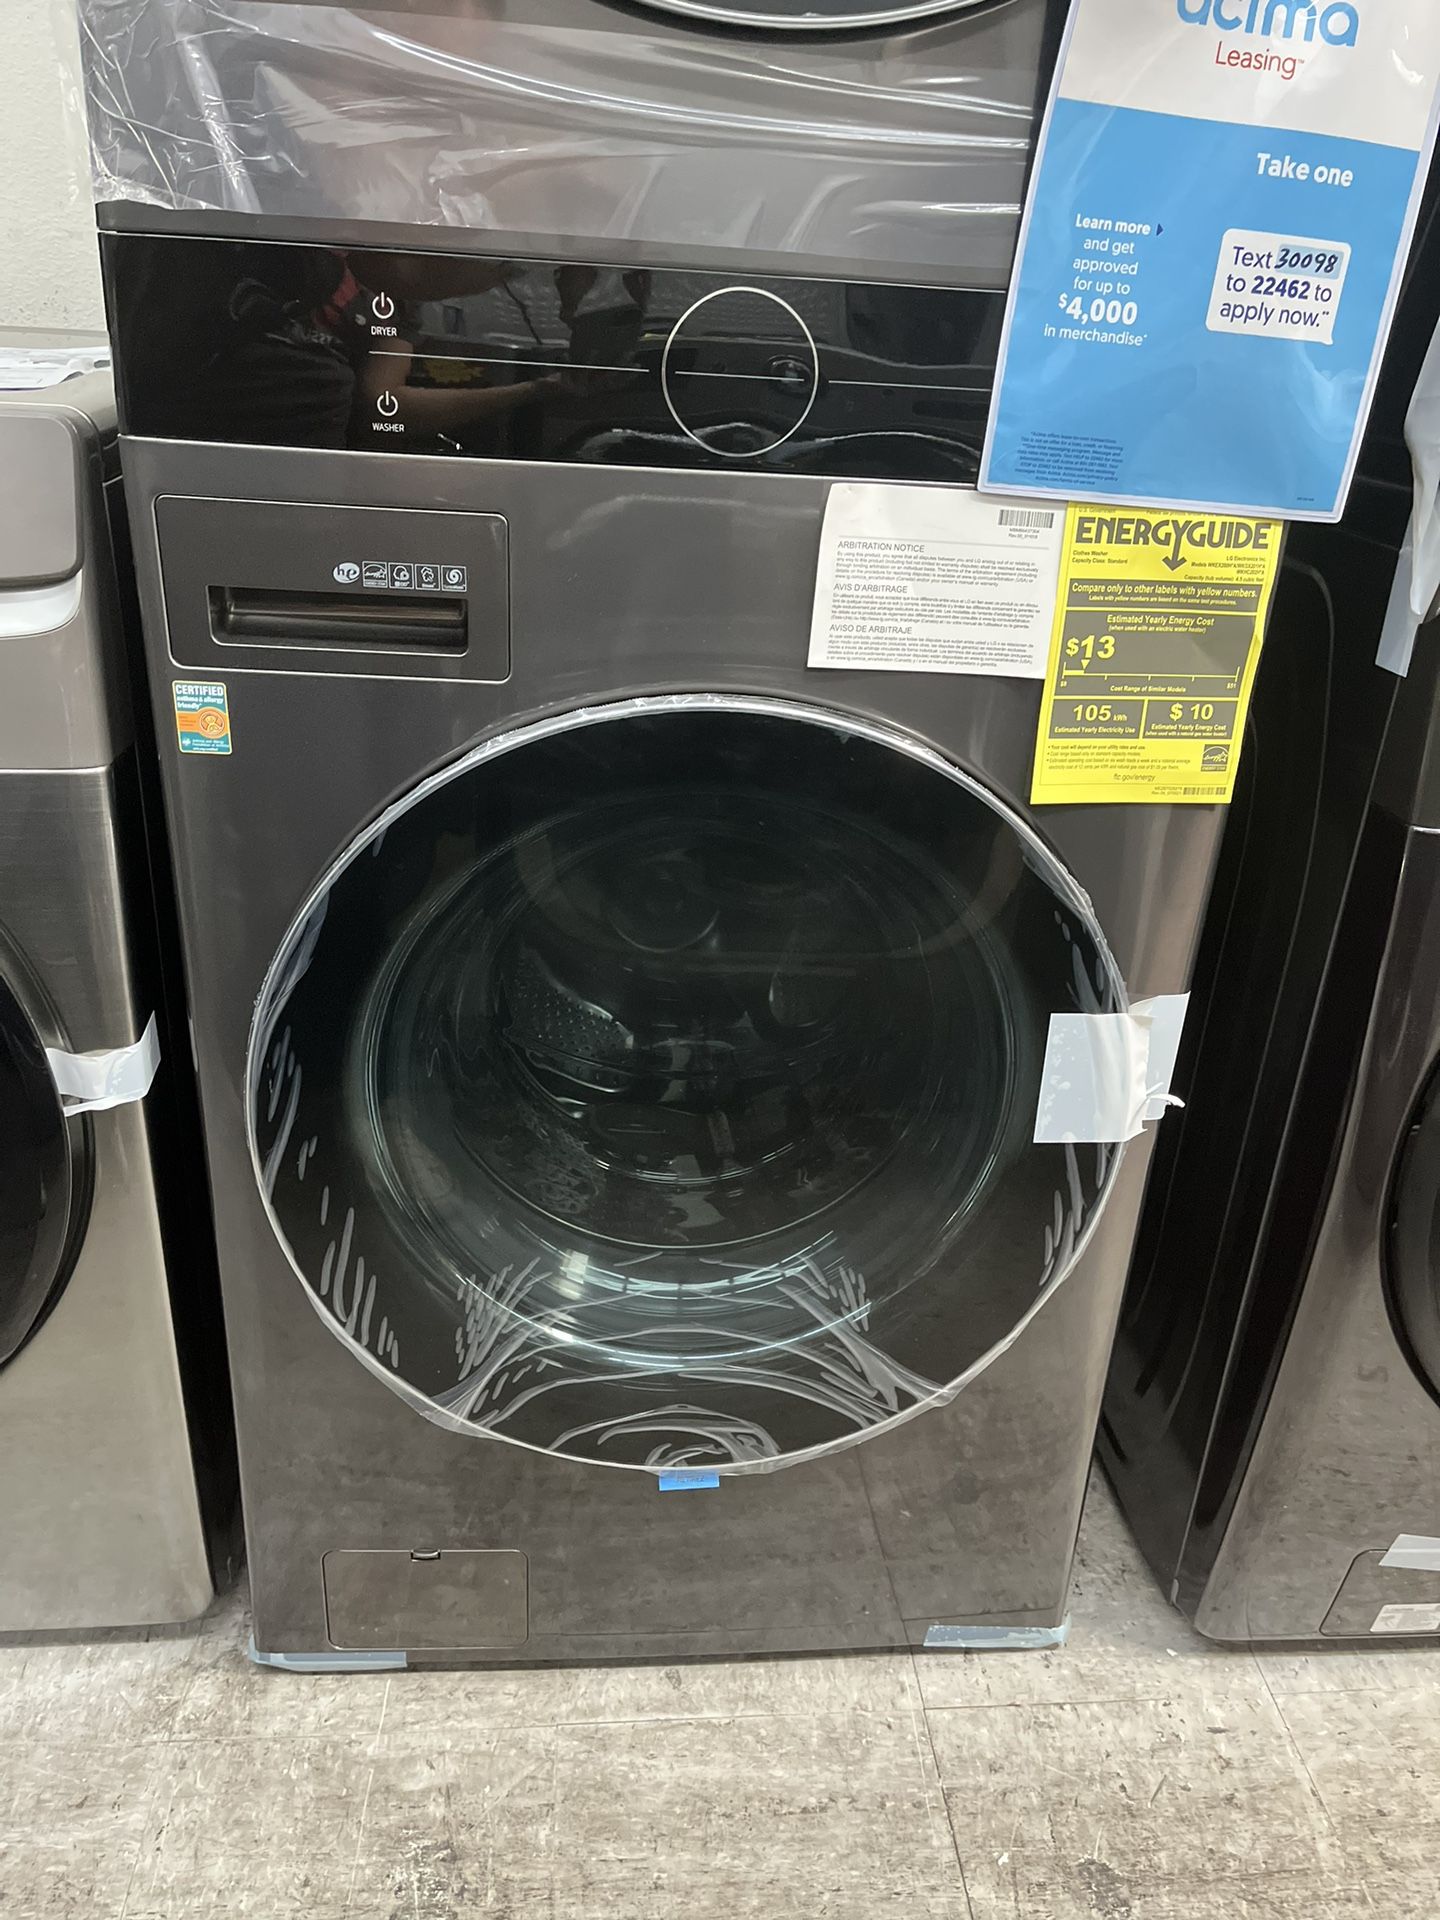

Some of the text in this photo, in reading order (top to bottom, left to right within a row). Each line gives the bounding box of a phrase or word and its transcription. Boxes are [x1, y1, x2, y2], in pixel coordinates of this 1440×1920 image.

[1177, 0, 1360, 47] acima
[1256, 152, 1354, 188] Take one
[1075, 213, 1151, 235] Learn more
[1083, 238, 1135, 256] and get
[1073, 258, 1139, 275] approved
[1233, 246, 1339, 273] Text 30098
[1073, 276, 1131, 295] for up to
[1226, 274, 1332, 302] to 22462 to
[1058, 292, 1138, 325] $4,000
[1220, 302, 1275, 326] apply
[370, 326, 397, 336] DRYER
[1044, 323, 1056, 337] in
[372, 422, 405, 432] WASHER
[1075, 516, 1272, 550] ENERGYGUIDE
[838, 541, 925, 552] ARBITRATION NOTICE
[833, 583, 852, 591] AVIS
[1072, 582, 1257, 598] Compare only to other labels with yellow numbers.
[829, 624, 854, 632] AVISO
[868, 625, 913, 634] ARBITRAJE
[1107, 614, 1215, 626] Estimated Yearly Energy Cost
[1065, 635, 1115, 659] $13
[175, 684, 224, 696] CERTIFIED
[1073, 704, 1112, 721] 105
[1169, 702, 1214, 721] $ 10
